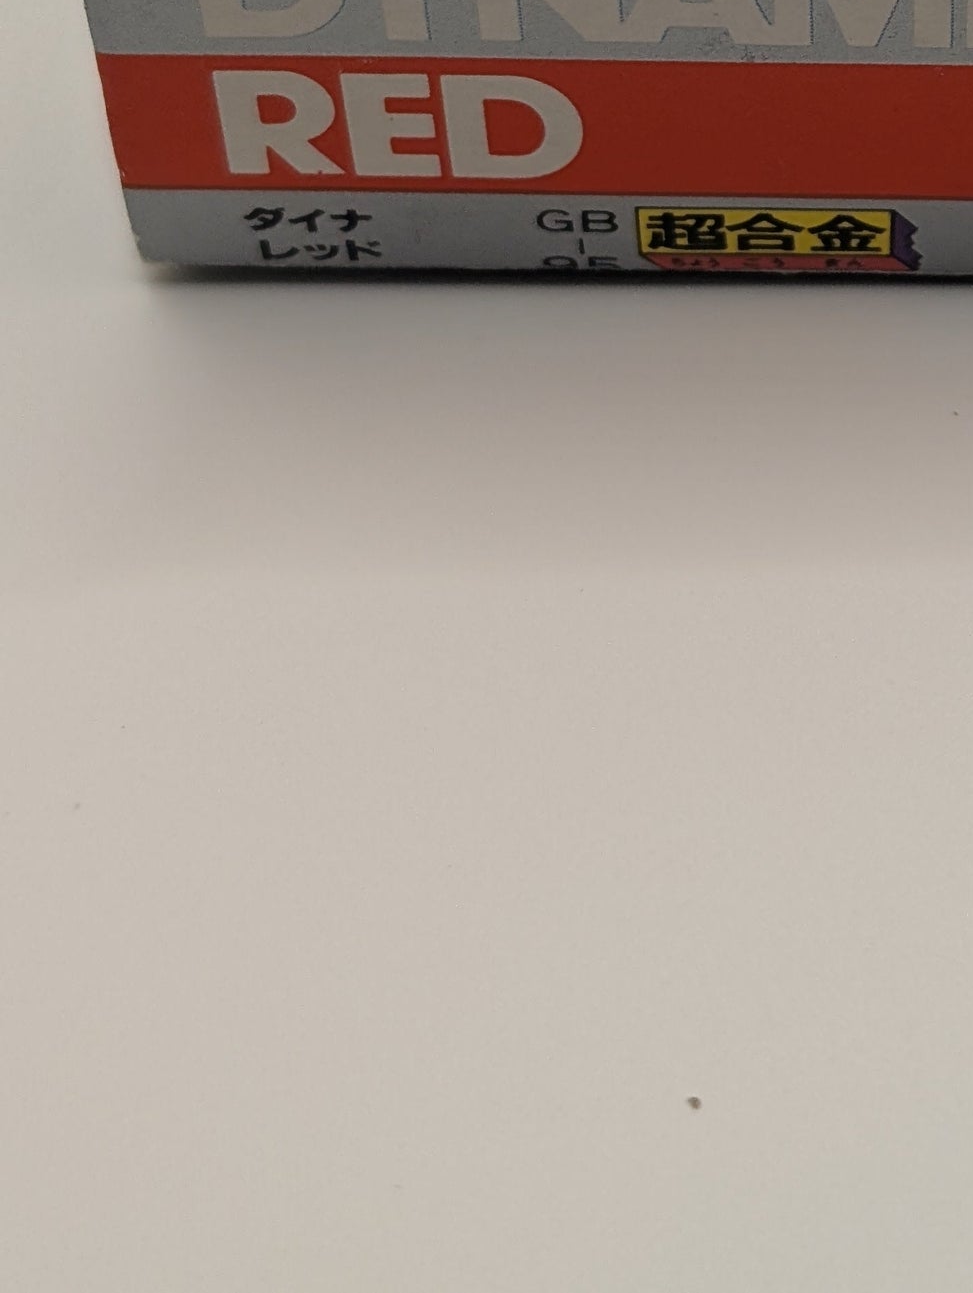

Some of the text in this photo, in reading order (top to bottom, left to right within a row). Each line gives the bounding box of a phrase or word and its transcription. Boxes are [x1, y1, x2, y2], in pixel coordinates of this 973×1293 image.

[213, 68, 585, 179] RED
[243, 206, 373, 232] ダイナ
[536, 209, 619, 233] GB
[645, 212, 887, 253] 超合金
[258, 238, 382, 261] レッド
